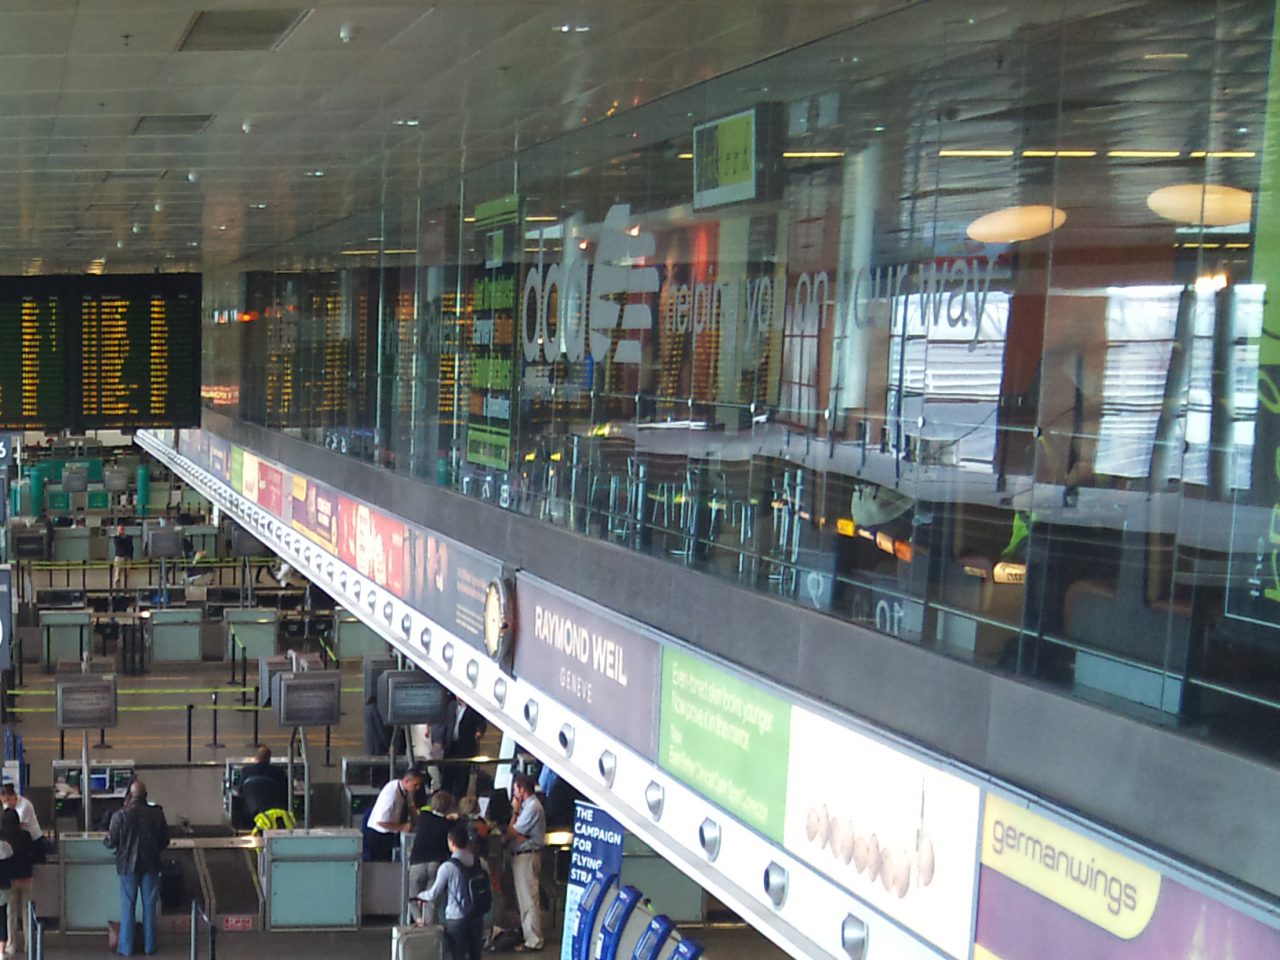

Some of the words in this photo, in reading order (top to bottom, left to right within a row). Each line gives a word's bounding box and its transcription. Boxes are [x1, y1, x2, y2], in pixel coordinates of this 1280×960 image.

[796, 271, 828, 332] on
[918, 258, 995, 352] way
[534, 605, 590, 664] RAYMOND
[592, 633, 628, 687] WEIL
[576, 806, 594, 822] THE
[573, 837, 593, 853] FOR
[574, 822, 622, 846] CAMPAIGN
[571, 852, 603, 870] FLYING
[992, 819, 1138, 917] germanwings
